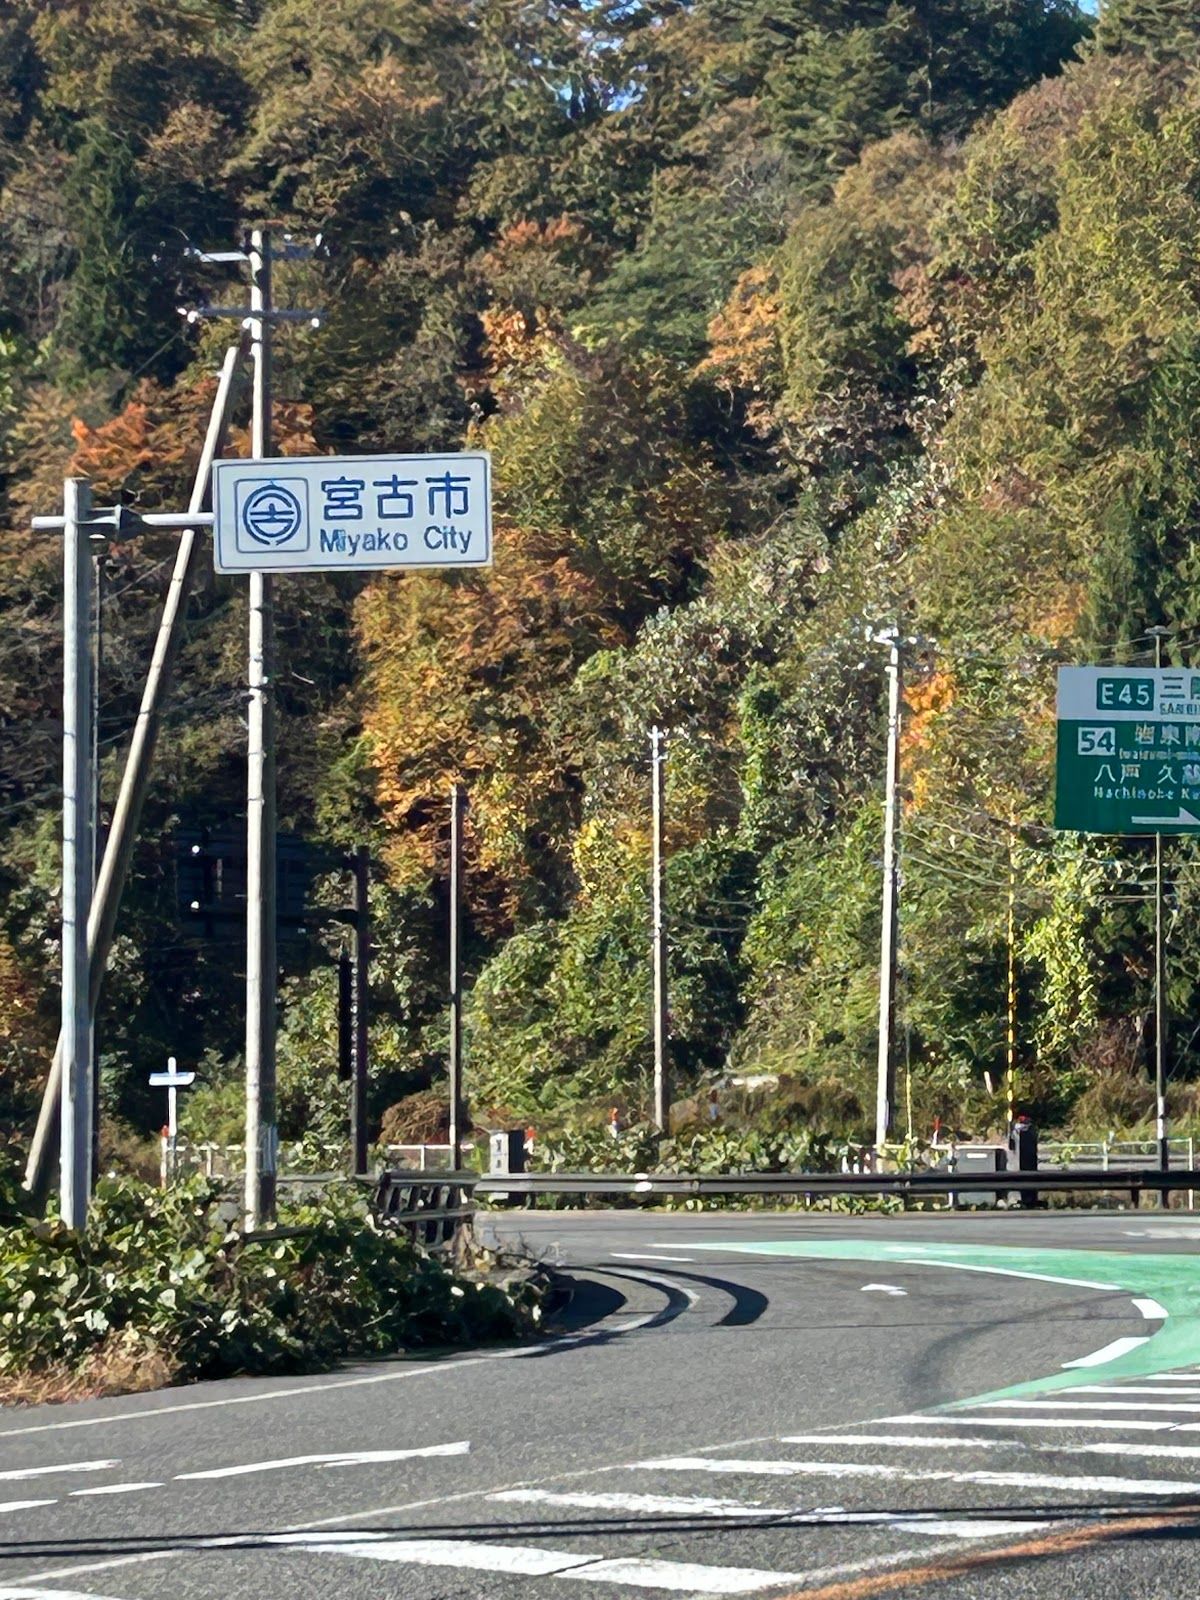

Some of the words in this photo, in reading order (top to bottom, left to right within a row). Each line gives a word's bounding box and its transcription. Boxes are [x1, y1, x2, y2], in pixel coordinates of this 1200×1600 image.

[321, 471, 471, 521] 宮古市
[319, 527, 408, 557] Miyako
[423, 525, 472, 555] City
[1101, 683, 1150, 706] E45
[1080, 730, 1115, 752] 54
